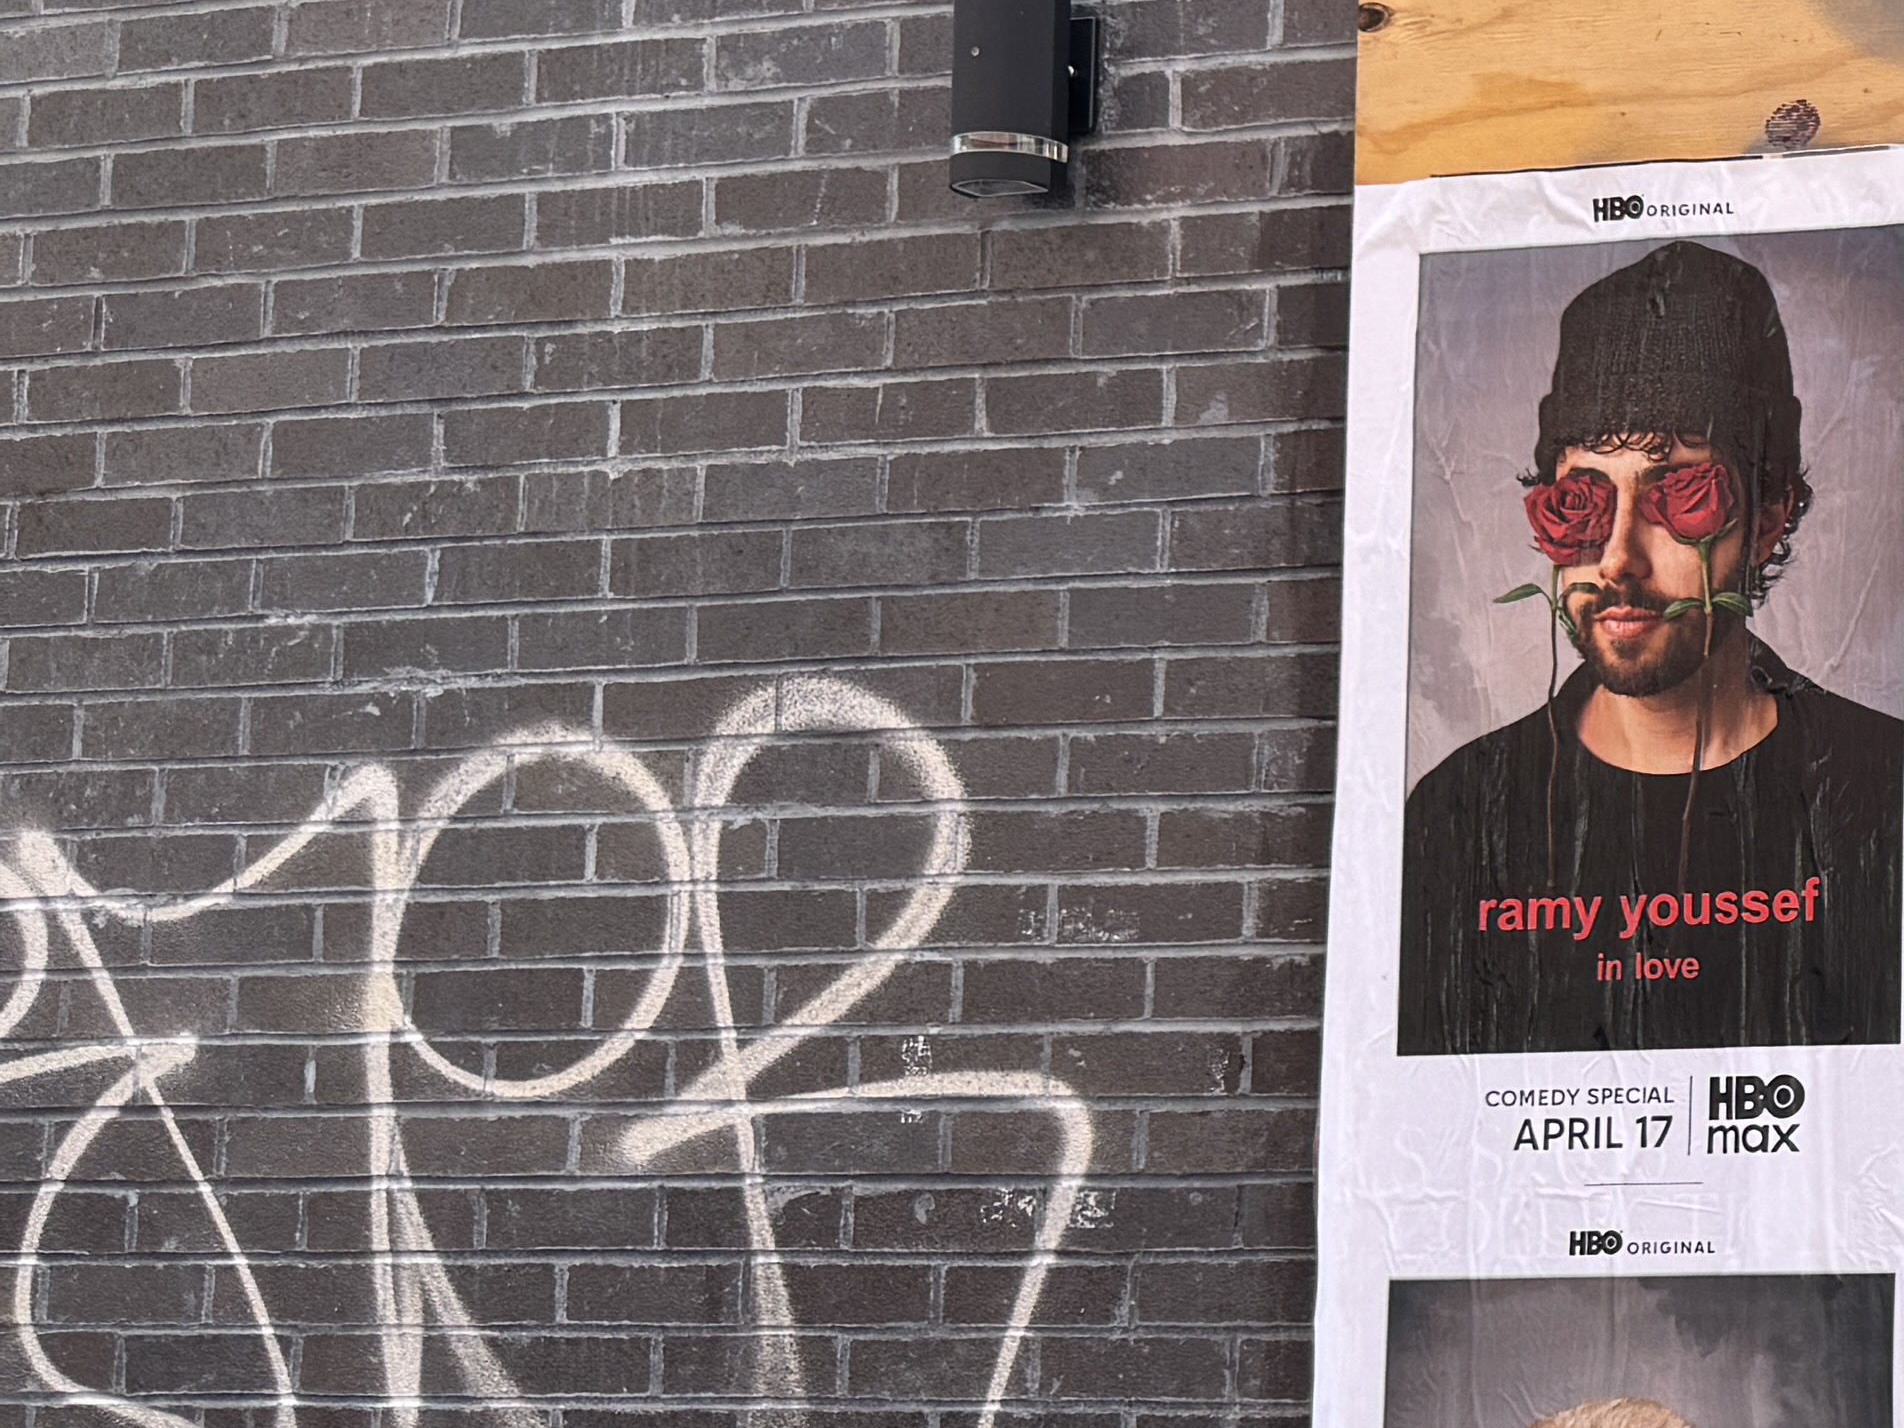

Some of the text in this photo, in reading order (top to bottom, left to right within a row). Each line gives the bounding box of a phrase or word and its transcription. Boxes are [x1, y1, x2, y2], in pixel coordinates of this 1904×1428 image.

[1593, 195, 1733, 222] HBO ORIGINAL
[1476, 876, 1819, 939] ramy youssef
[1597, 953, 1698, 980] in love
[1486, 1087, 1674, 1106] COMEDY SPECIAL
[1709, 1075, 1805, 1120] HBO
[1514, 1116, 1672, 1150] APRIL 17
[1707, 1124, 1799, 1154] max
[1569, 1230, 1715, 1255] HBO ORIGINAL
